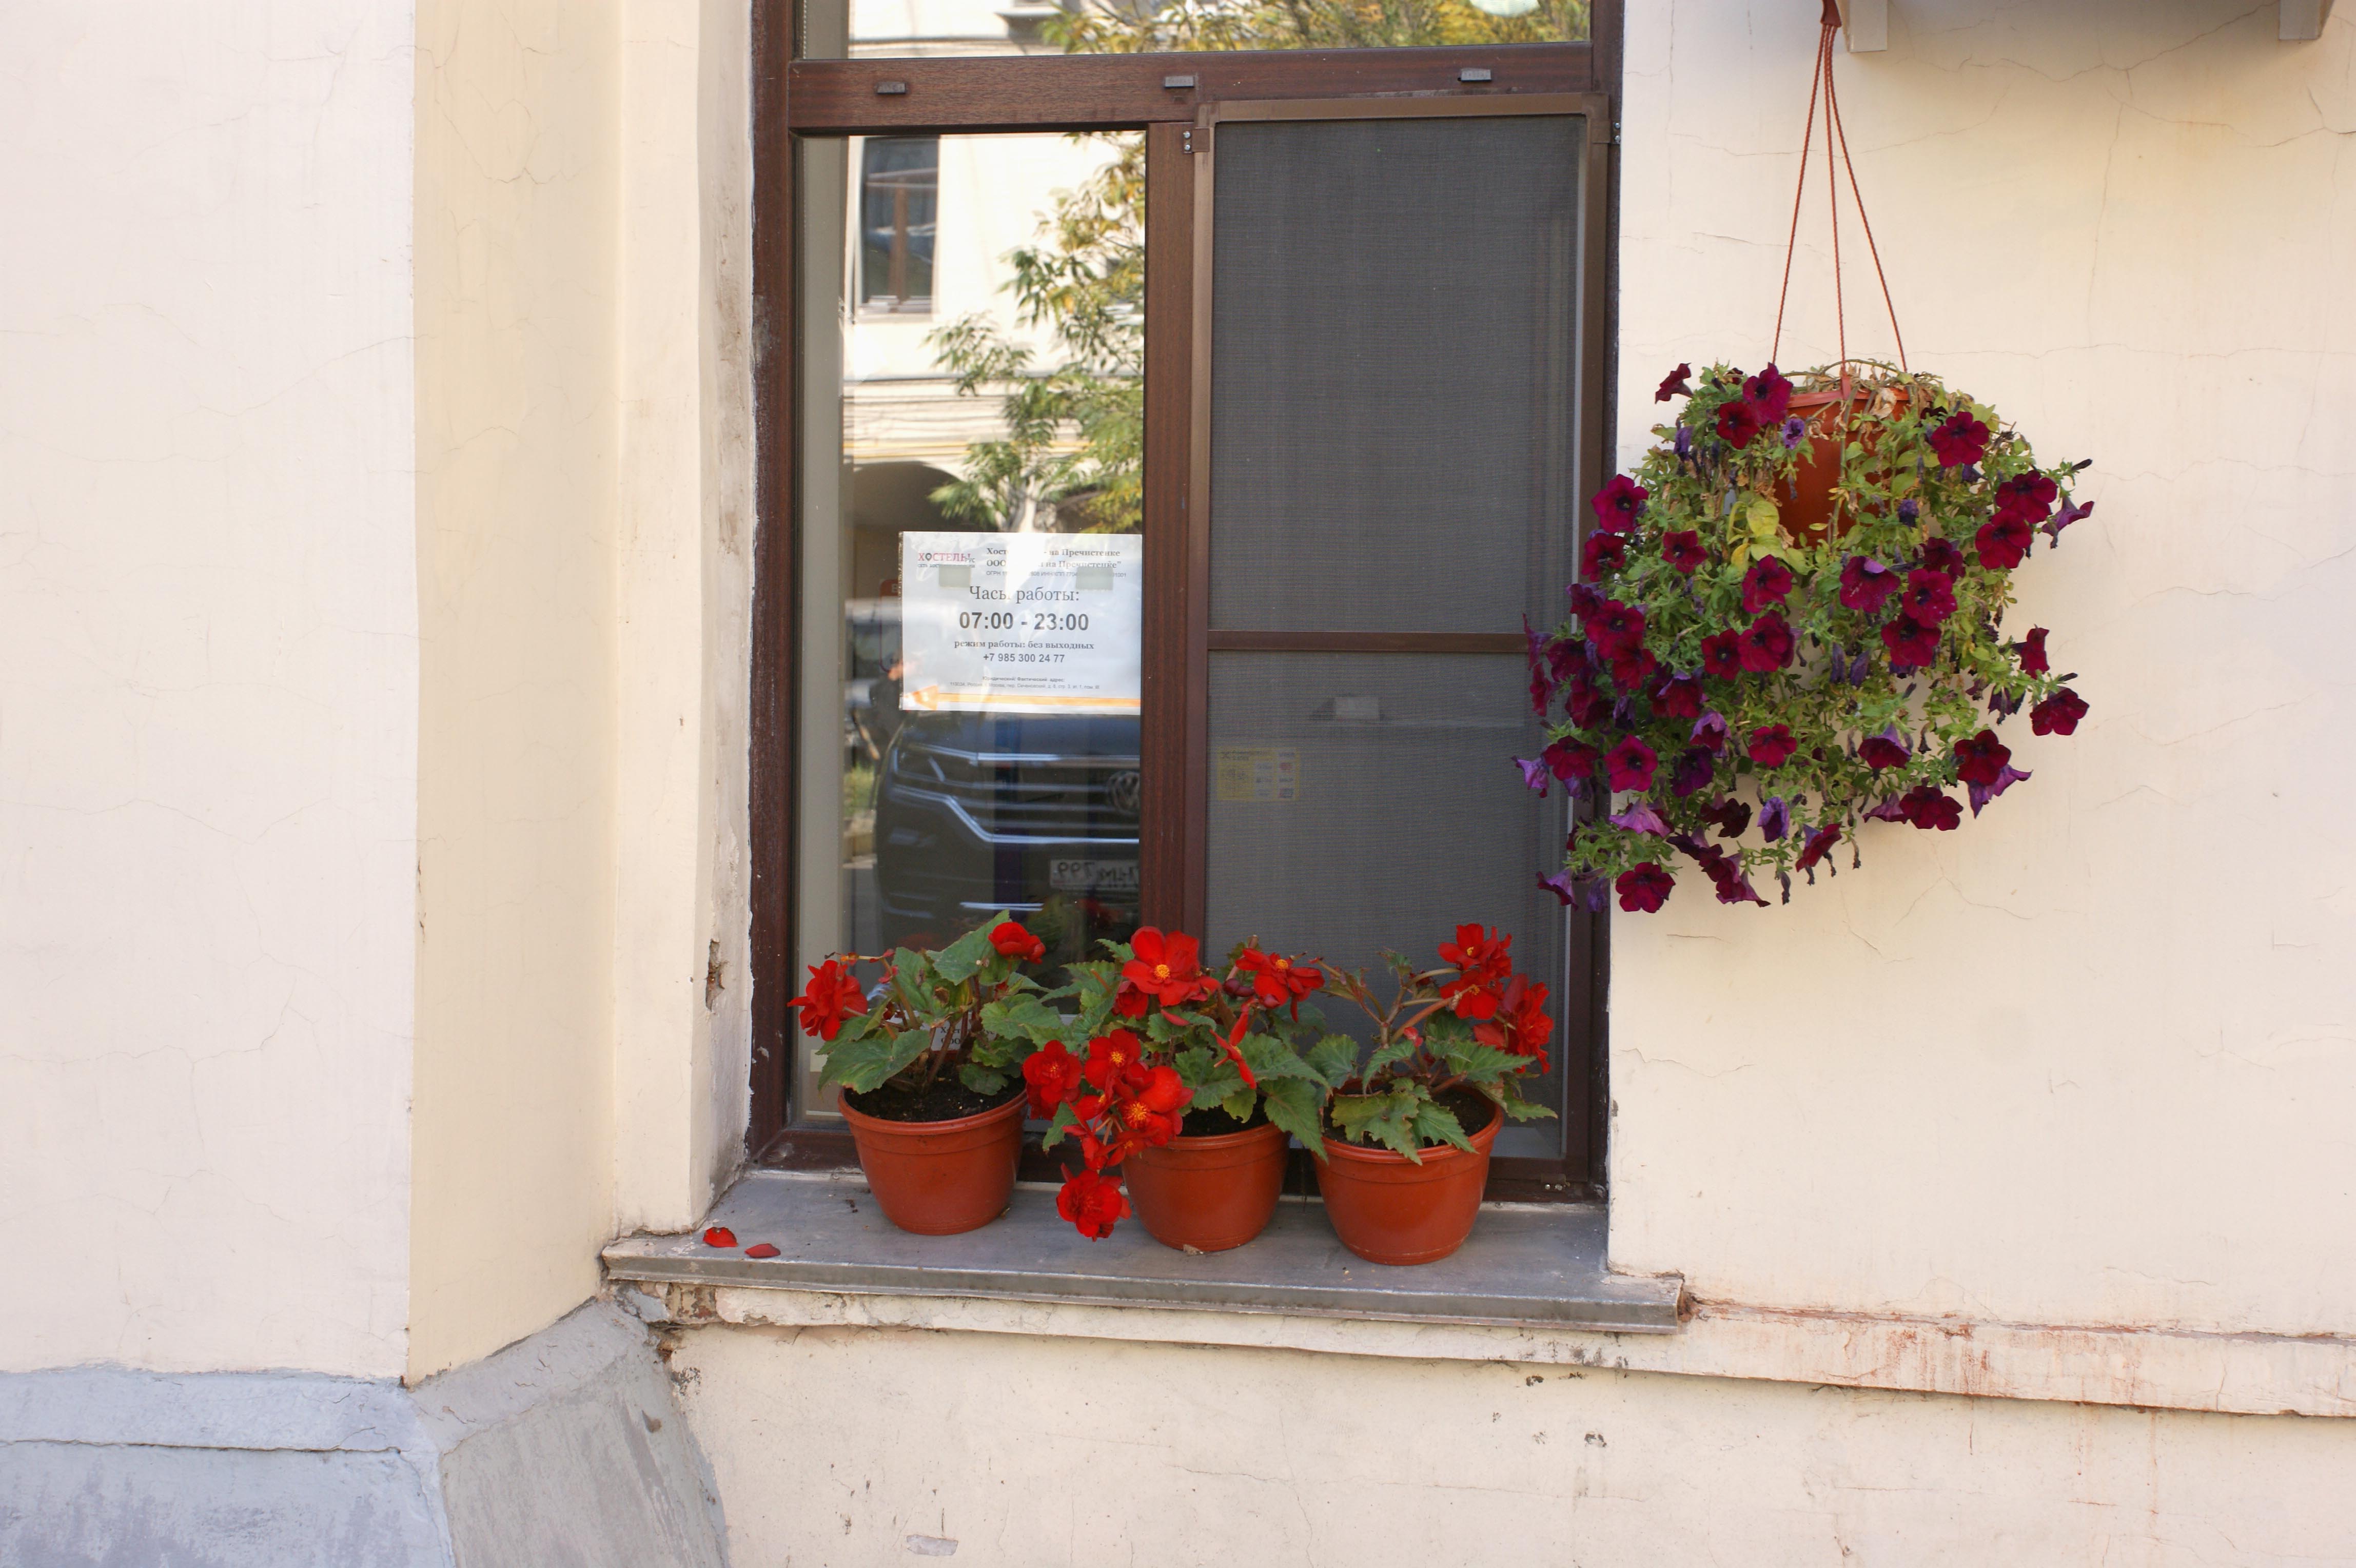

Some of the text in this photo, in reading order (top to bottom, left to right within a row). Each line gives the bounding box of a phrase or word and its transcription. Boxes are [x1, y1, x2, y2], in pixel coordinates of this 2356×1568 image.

[1062, 549, 1121, 558] Пречистенке
[970, 586, 1079, 604] Часы работы:
[959, 611, 1014, 630] 07:00
[1034, 613, 1089, 631] 23:00
[954, 640, 986, 649] режим
[988, 640, 1026, 650] работы:
[1028, 640, 1044, 649] без
[983, 653, 1065, 663] +7 985 300 24 77
